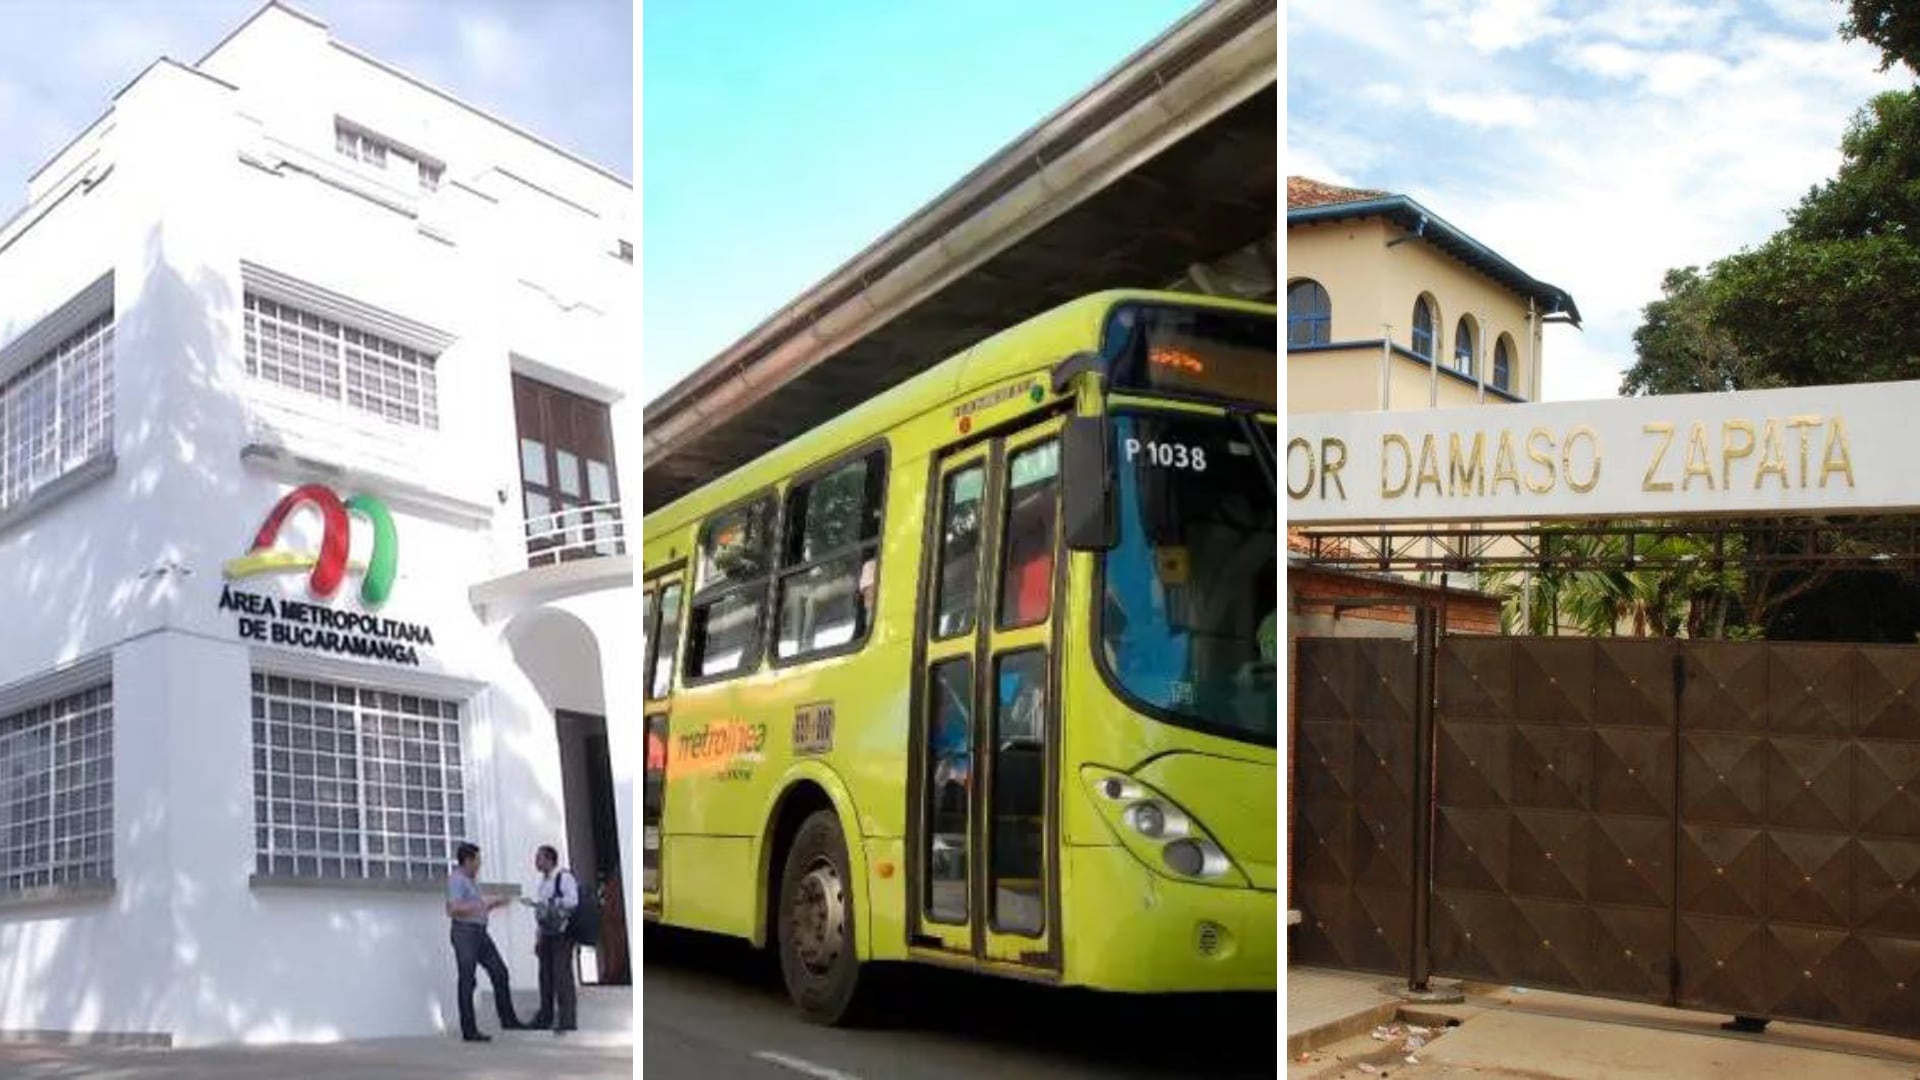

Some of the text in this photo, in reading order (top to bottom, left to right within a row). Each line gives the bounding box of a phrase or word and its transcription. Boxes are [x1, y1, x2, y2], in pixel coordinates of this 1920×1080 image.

[1125, 438, 1207, 471] P 1038
[1287, 413, 1856, 501] OR DAMASO ZAPATA
[219, 584, 434, 645] ÁREA METROPOLITANA
[239, 618, 419, 666] DE BUCARAMANGA
